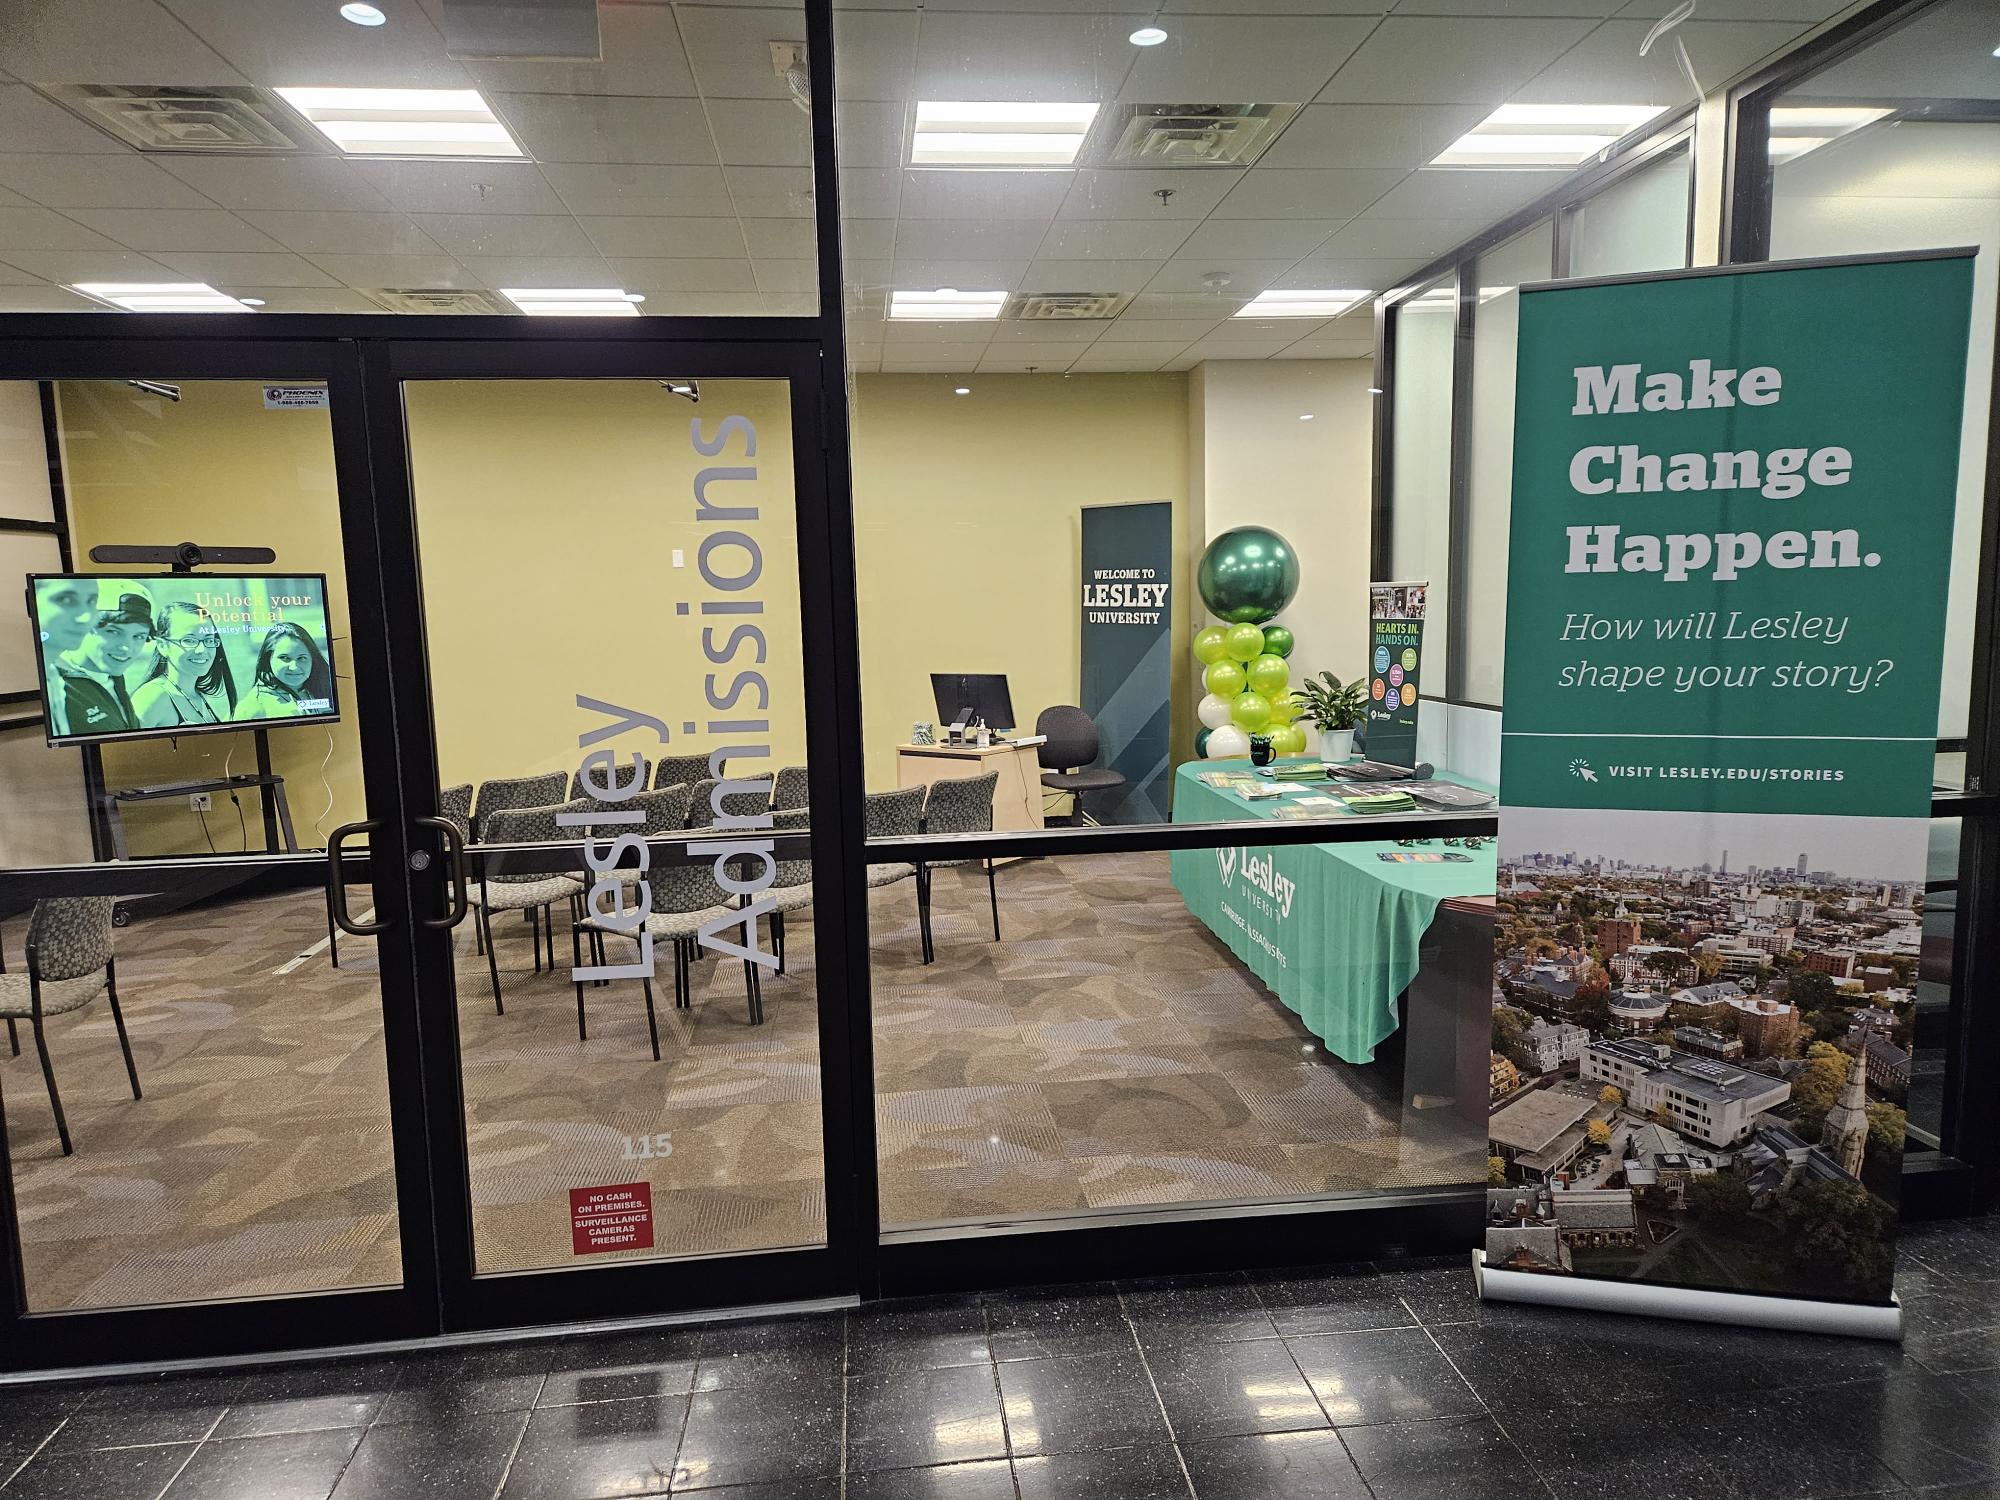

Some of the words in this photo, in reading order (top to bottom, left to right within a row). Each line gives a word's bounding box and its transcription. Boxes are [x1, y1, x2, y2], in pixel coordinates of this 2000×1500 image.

[1572, 359, 1782, 415] Make
[1569, 444, 1852, 500] Change
[1564, 525, 1882, 582] Happen.
[1094, 570, 1141, 580] WELCOME
[1142, 569, 1155, 579] TO
[271, 595, 312, 609] your
[1083, 583, 1169, 607] LESLEY
[1089, 612, 1160, 625] UNIVERSITY
[199, 626, 209, 634] At
[213, 625, 241, 634] Lesley
[1376, 622, 1407, 634] HEARTS
[1408, 624, 1419, 634] IN.
[1560, 613, 1643, 641] How
[1654, 612, 1717, 640] will
[1723, 611, 1849, 644] Lesley
[1376, 634, 1402, 645] HANDS
[1403, 635, 1419, 646] ON.
[1558, 660, 1666, 692] shape
[1674, 665, 1766, 693] your
[1772, 659, 1895, 693] story?
[677, 415, 780, 969] Admissions
[1608, 765, 1653, 778] VISIT
[1659, 766, 1845, 782] LESLEY.EDU/STORIES
[556, 694, 669, 981] Lesley
[1240, 846, 1296, 918] Lesley
[621, 1132, 673, 1160] 115
[590, 1195, 604, 1203] NO
[606, 1192, 632, 1201] CASH
[578, 1205, 592, 1213] ON
[594, 1200, 646, 1212] PREMISES.
[575, 1214, 648, 1228] SURVEILLANCE
[588, 1225, 635, 1236] CAMERAS
[591, 1234, 637, 1246] PRESENT.
